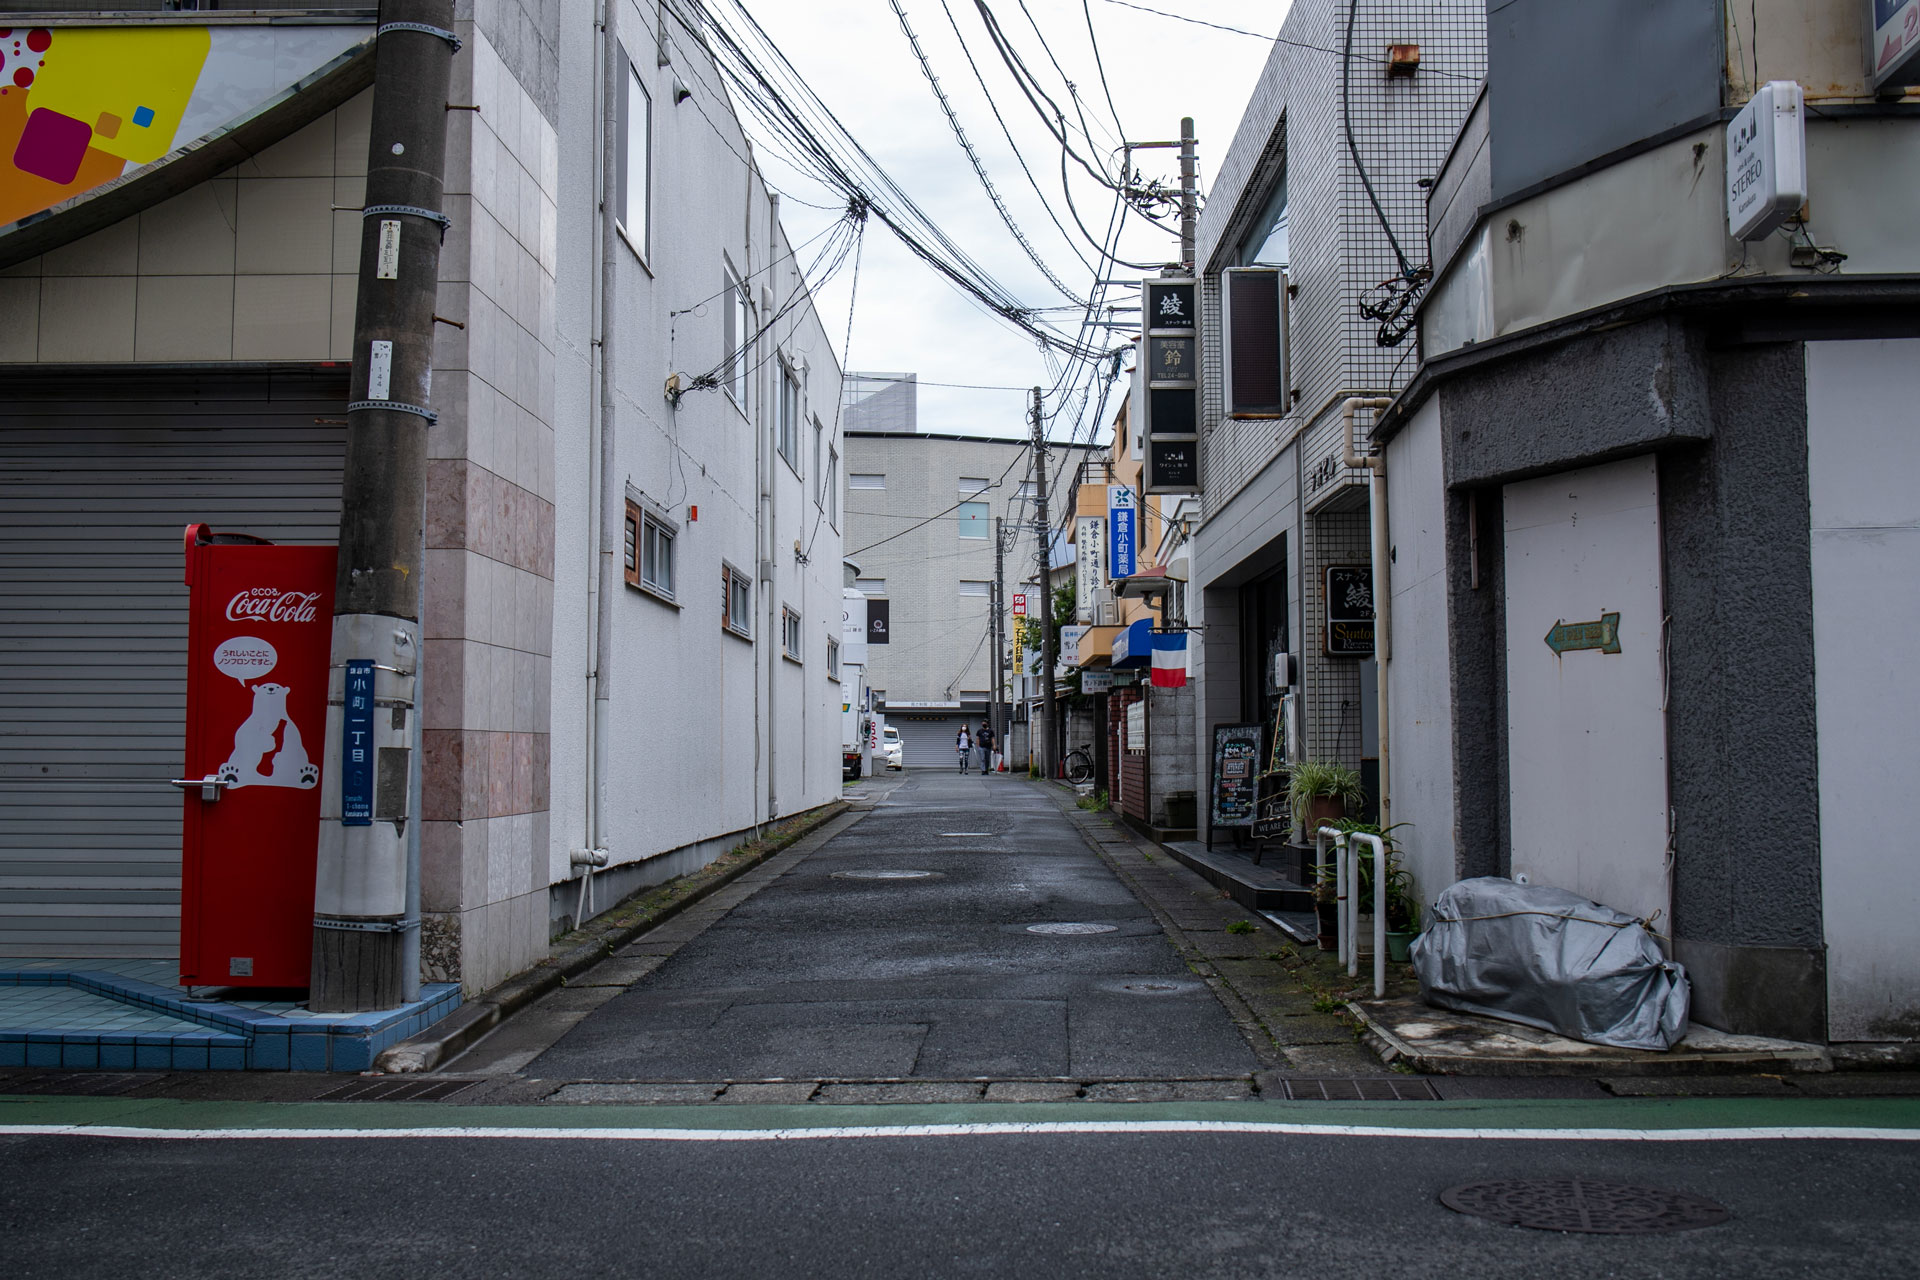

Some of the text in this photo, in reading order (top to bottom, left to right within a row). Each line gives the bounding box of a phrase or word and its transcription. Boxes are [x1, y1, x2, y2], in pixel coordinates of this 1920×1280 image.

[1732, 159, 1762, 202] STEREO
[1160, 293, 1185, 316] 綾
[1164, 350, 1182, 366] 鈴
[1117, 511, 1129, 575] 鎌倉小町薬局
[1090, 520, 1101, 593] 鎌倉小町通り診
[1336, 572, 1369, 582] スナック
[225, 590, 323, 623] Coca-Cola
[1344, 583, 1373, 609] 綾
[218, 658, 273, 666] ノンフロンですと。
[222, 649, 269, 657] うれしいことに
[351, 678, 366, 763] 小町一丁目
